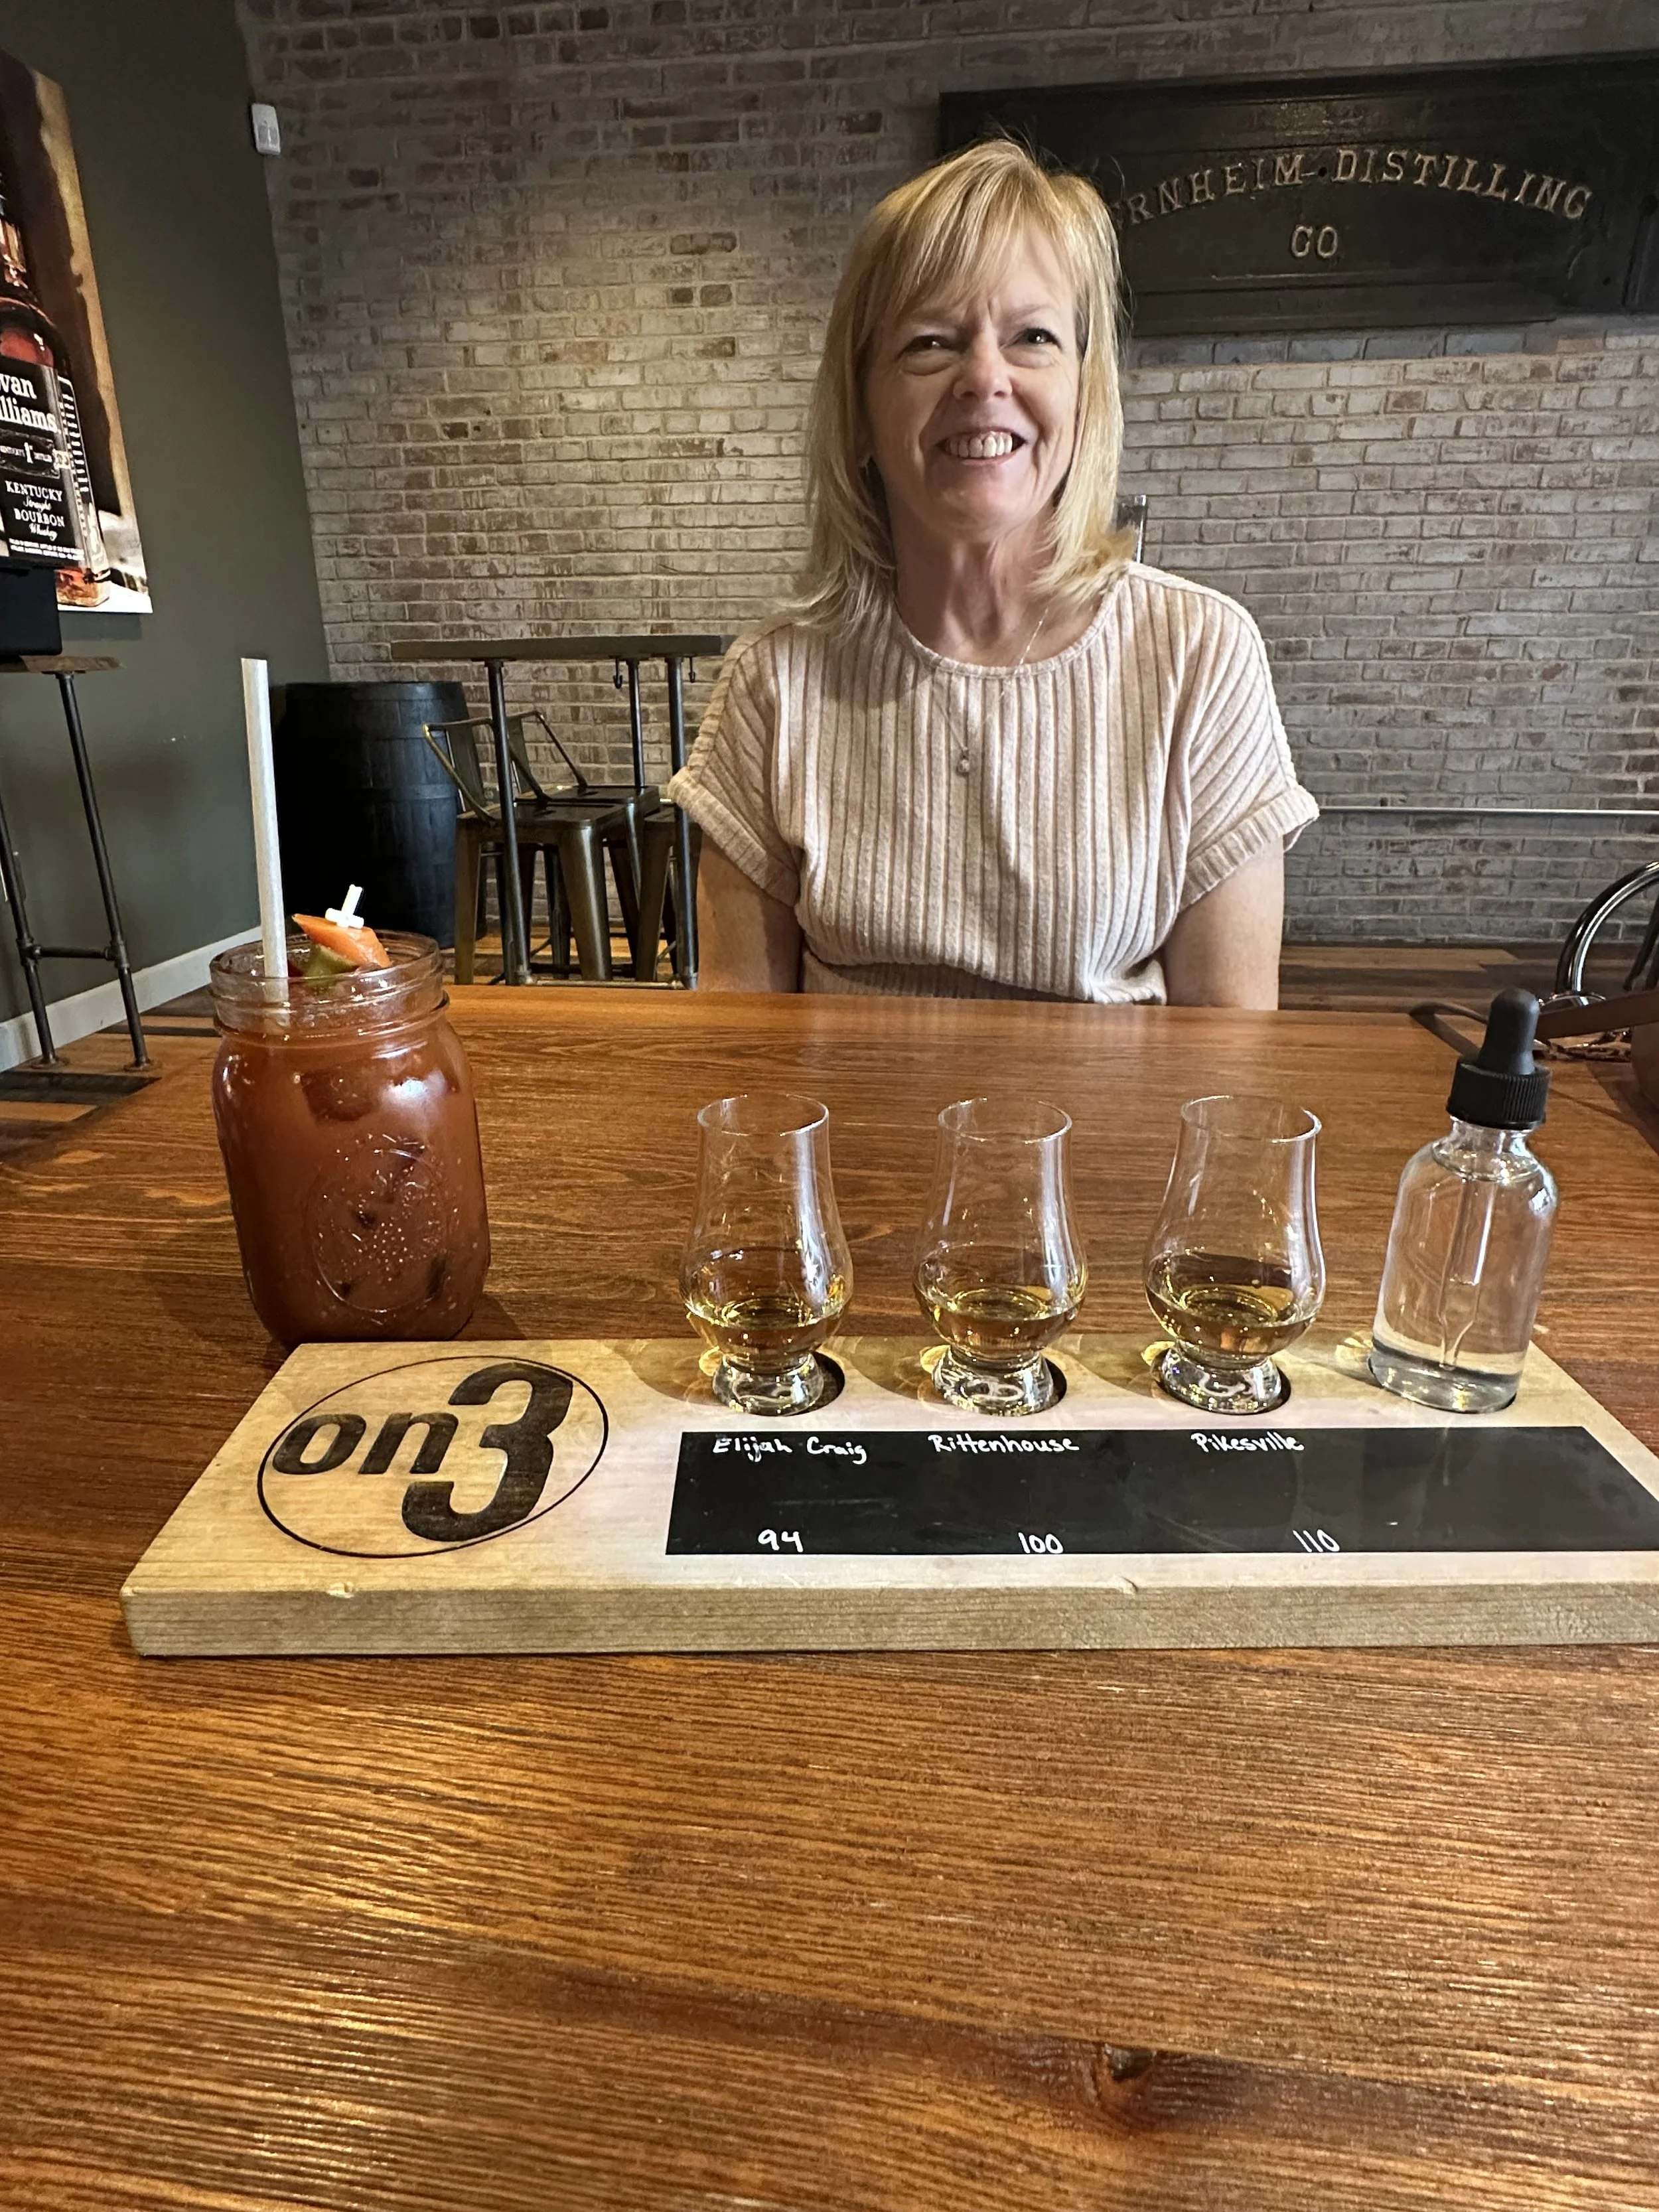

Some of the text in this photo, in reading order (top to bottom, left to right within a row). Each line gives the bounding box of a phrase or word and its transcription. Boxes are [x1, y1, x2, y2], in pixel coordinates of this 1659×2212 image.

[1331, 148, 1593, 220] DISTILLING
[1291, 225, 1338, 258] CO
[0, 372, 37, 399] van
[5, 480, 63, 502] KENTUCKY
[13, 508, 65, 528] BOURBON
[272, 1361, 573, 1542] on3
[712, 1436, 868, 1464] Elijah Craig
[928, 1433, 1080, 1453] Rittenhouse
[1191, 1431, 1305, 1453] Pikesville
[757, 1528, 804, 1553] 94
[1017, 1532, 1064, 1554] 100
[1292, 1529, 1340, 1553] 110
